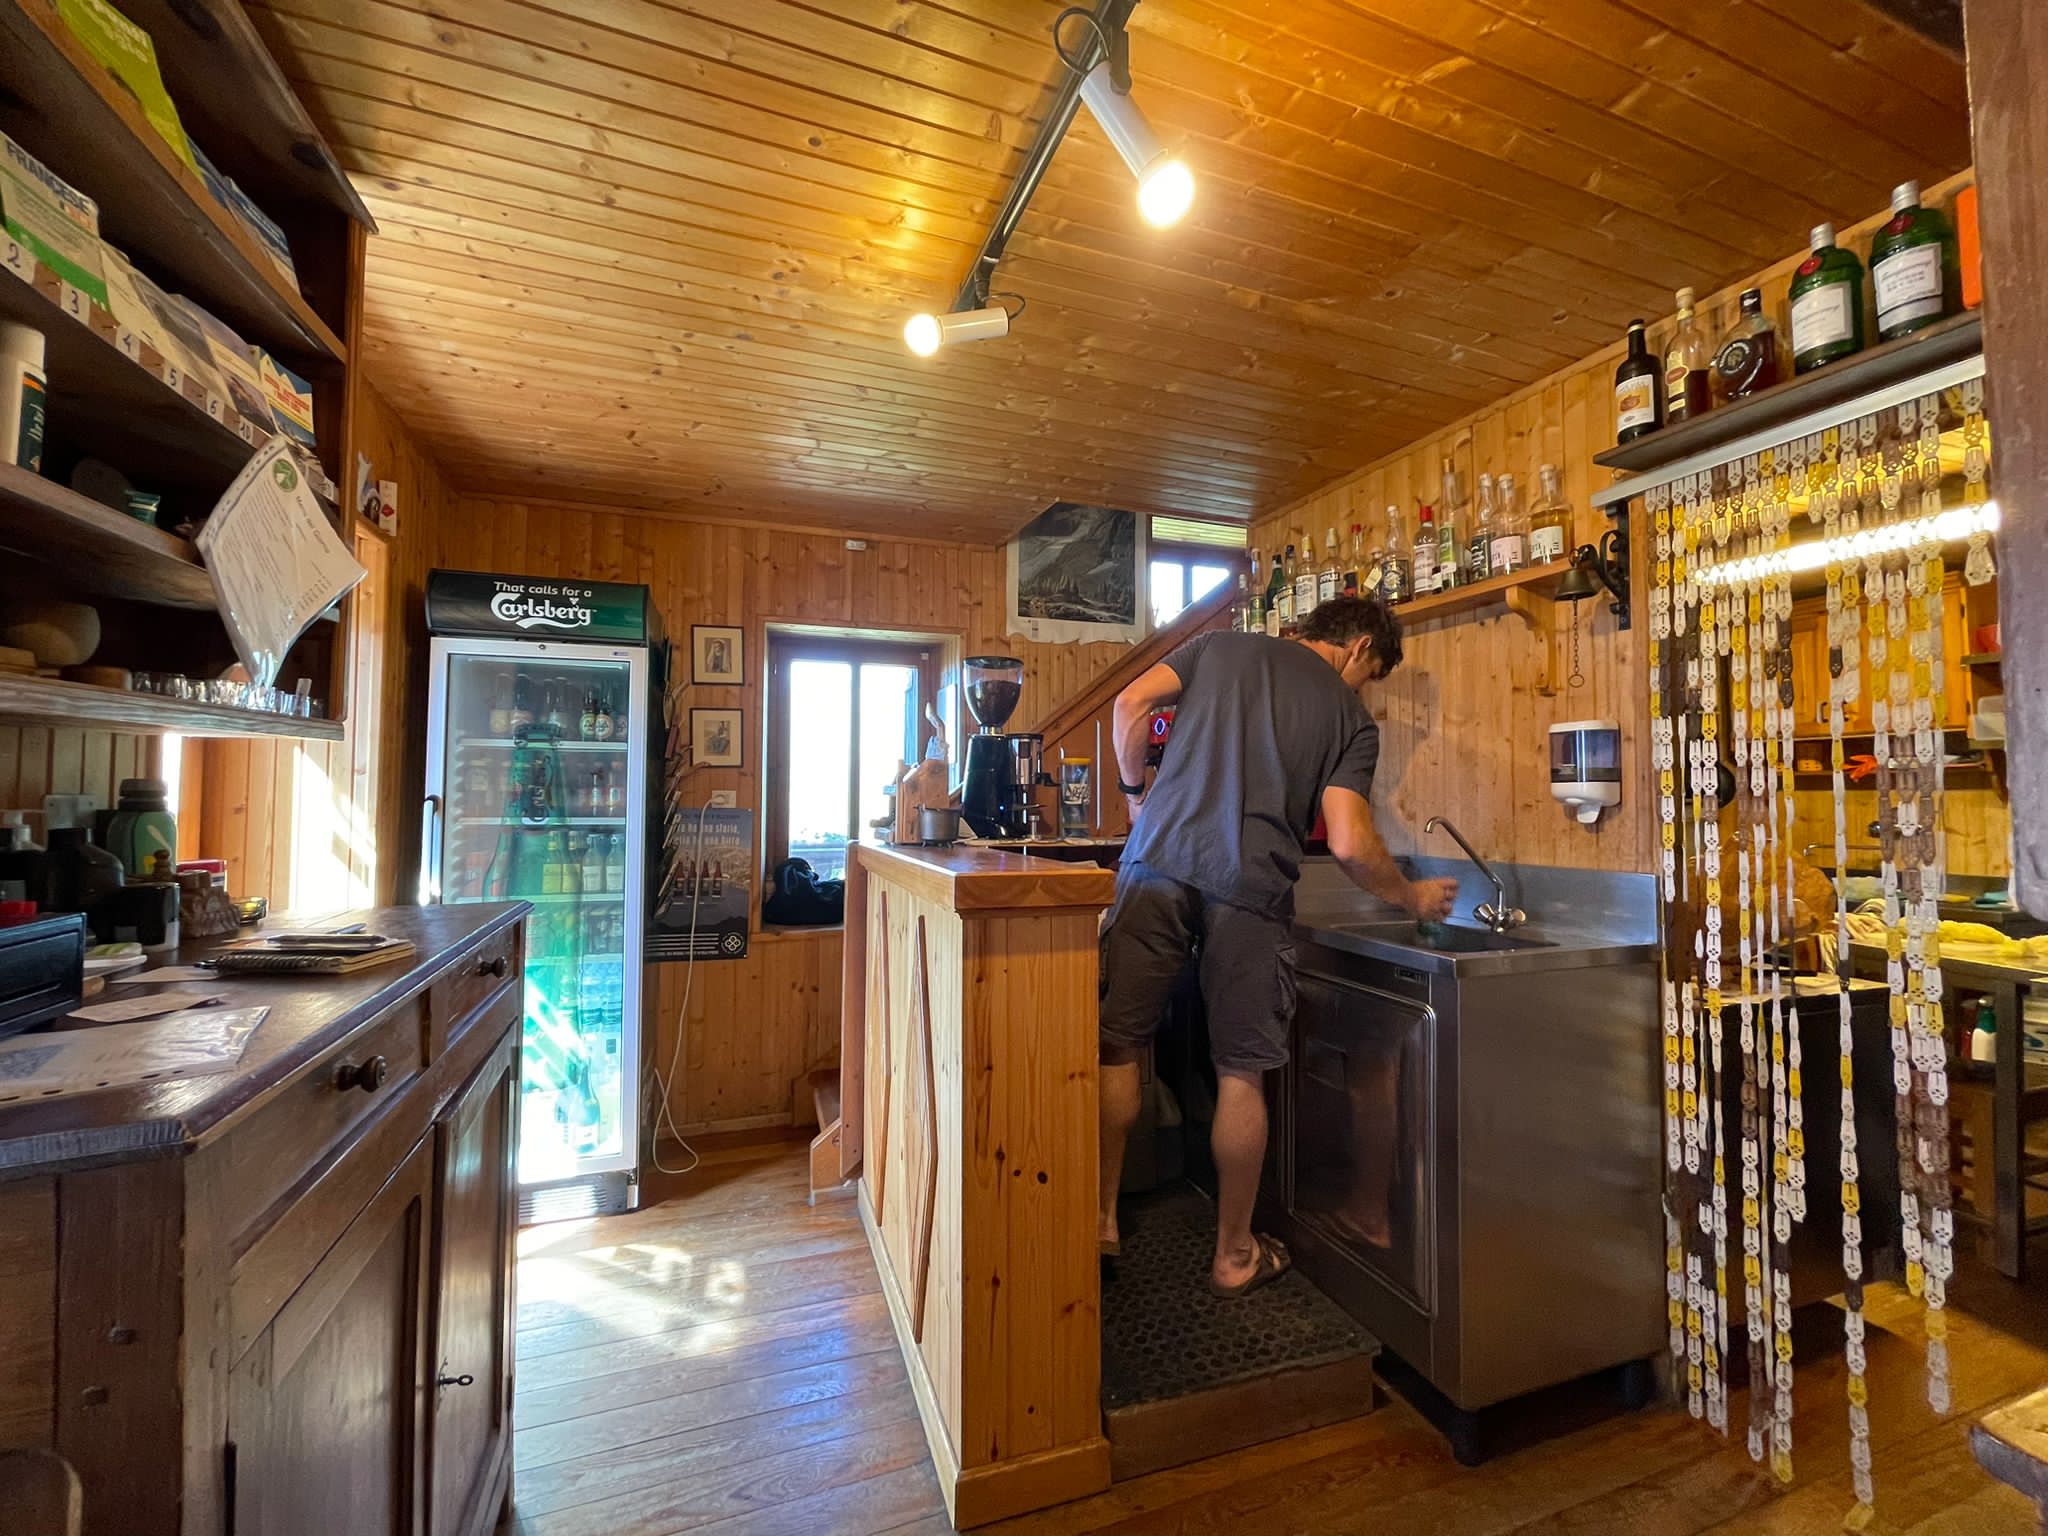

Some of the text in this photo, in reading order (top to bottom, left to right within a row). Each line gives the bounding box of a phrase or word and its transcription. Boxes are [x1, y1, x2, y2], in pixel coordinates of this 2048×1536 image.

[7, 242, 21, 268] 2
[71, 289, 80, 314] 3
[121, 333, 132, 354] 4
[168, 367, 178, 387] 5
[209, 399, 218, 416] 6
[494, 581, 592, 598] That calls for a
[490, 591, 592, 629] Carlsberg
